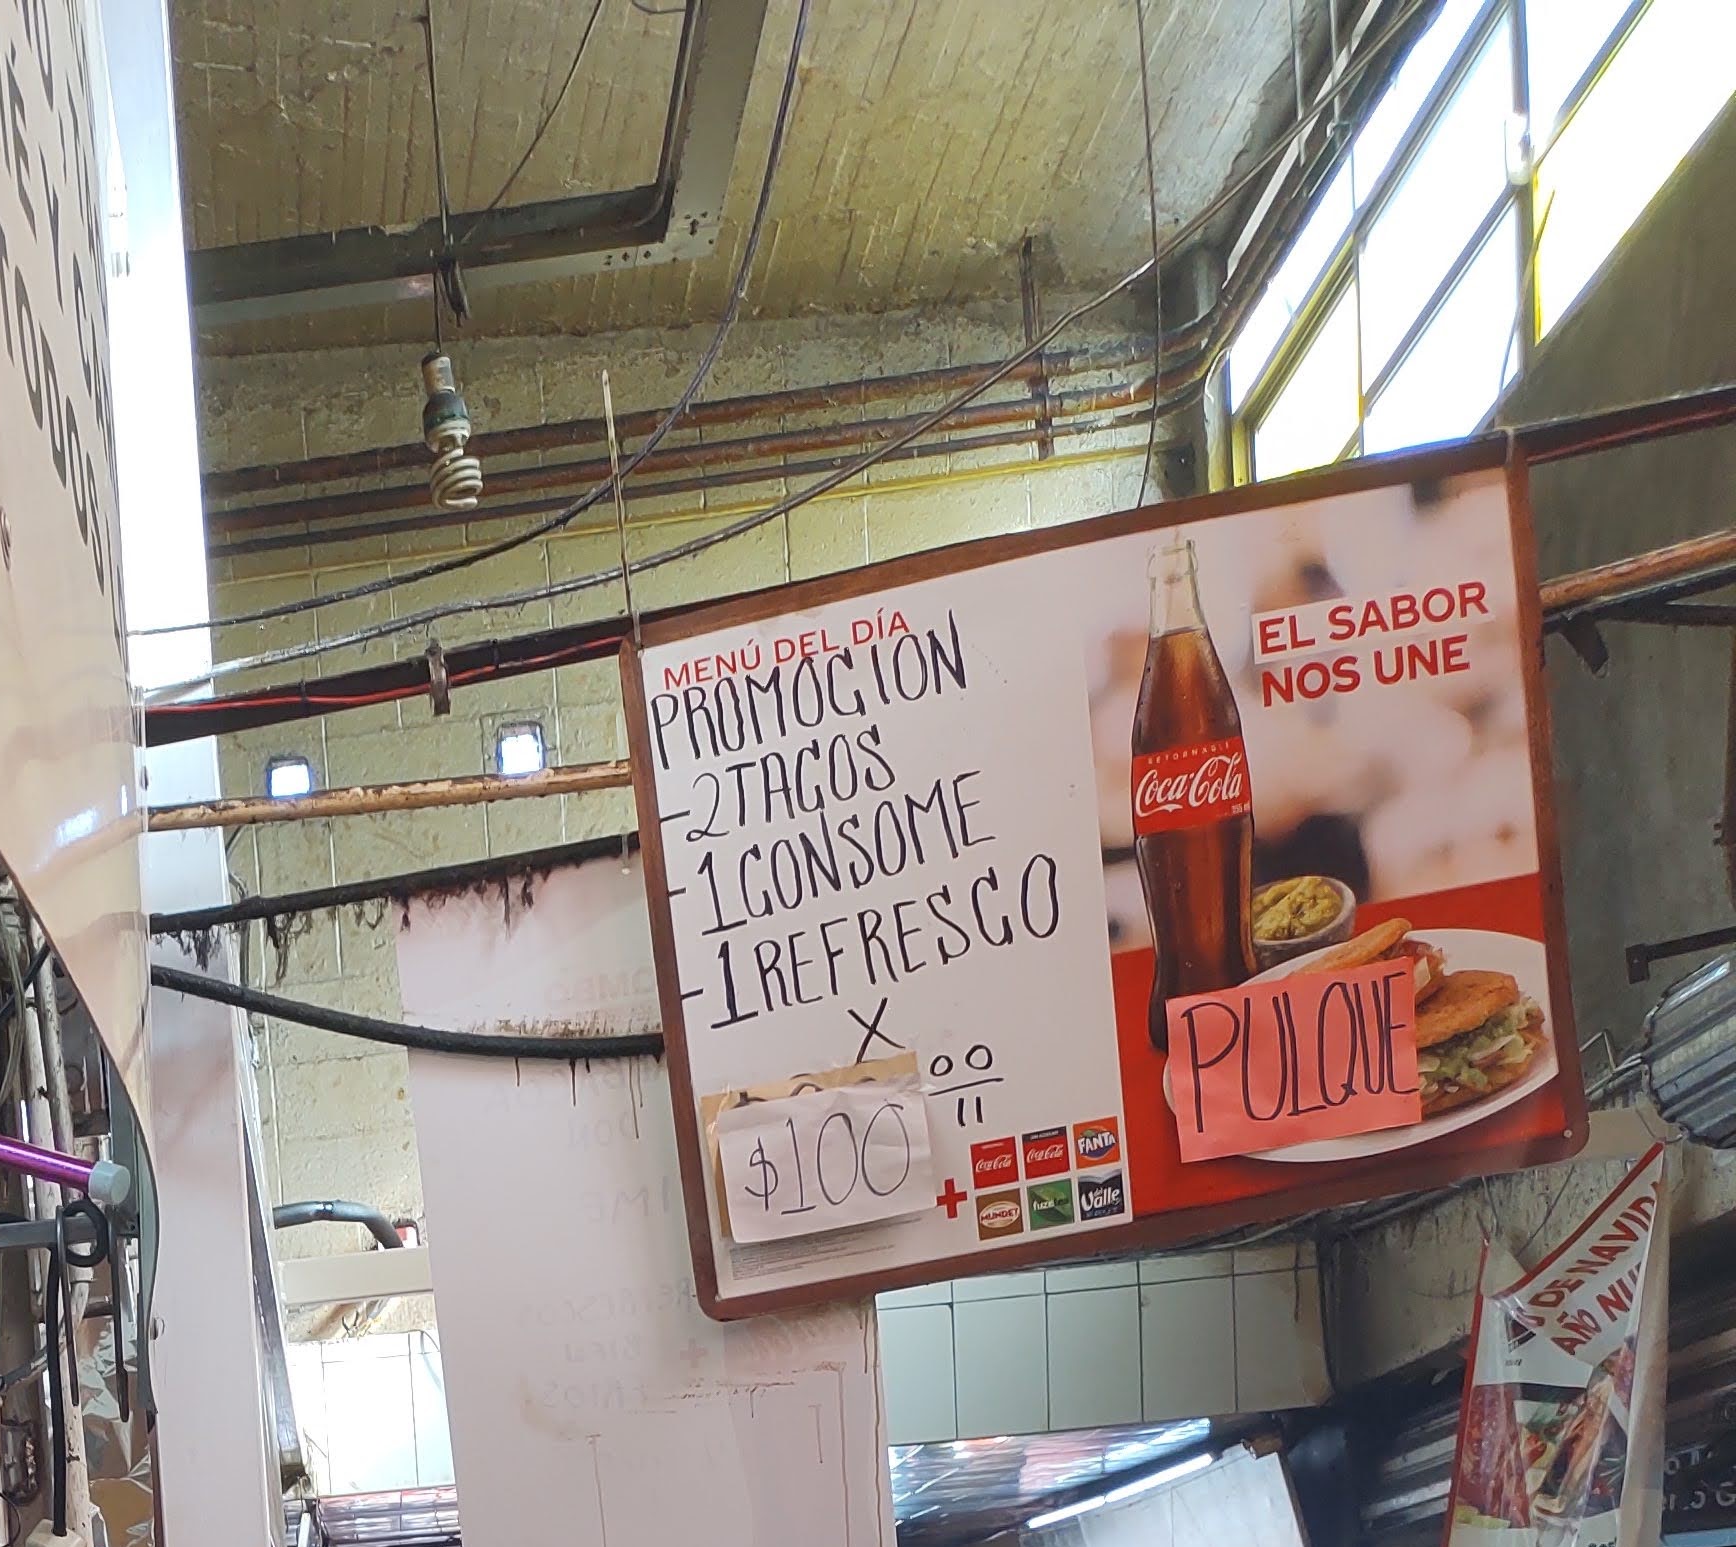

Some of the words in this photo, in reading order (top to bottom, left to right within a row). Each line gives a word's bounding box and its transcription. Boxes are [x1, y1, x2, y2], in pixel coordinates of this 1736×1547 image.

[38, 148, 64, 317] Y
[663, 638, 762, 690] MENÚ
[774, 629, 841, 665] DEL
[851, 607, 910, 647] DÍA
[1258, 616, 1315, 656] EL
[1328, 581, 1489, 641] SABOR
[650, 609, 967, 770] PROMOCION
[1262, 657, 1361, 708] NOS
[1374, 635, 1471, 687] UNE
[1135, 752, 1243, 817] Coca-Cola
[1181, 971, 1421, 1134] PULQUE
[745, 1099, 911, 1216] $100
[975, 1154, 1013, 1173] Coca-Cola
[1026, 1144, 1064, 1164] Coca-Cola
[1077, 1131, 1116, 1155] FANTA
[980, 1207, 1020, 1222] MUNDET
[1081, 1187, 1122, 1213] Valle
[1528, 1278, 1585, 1308] DE
[1566, 1190, 1657, 1275] NAVID
[1550, 1308, 1602, 1356] AÑO
